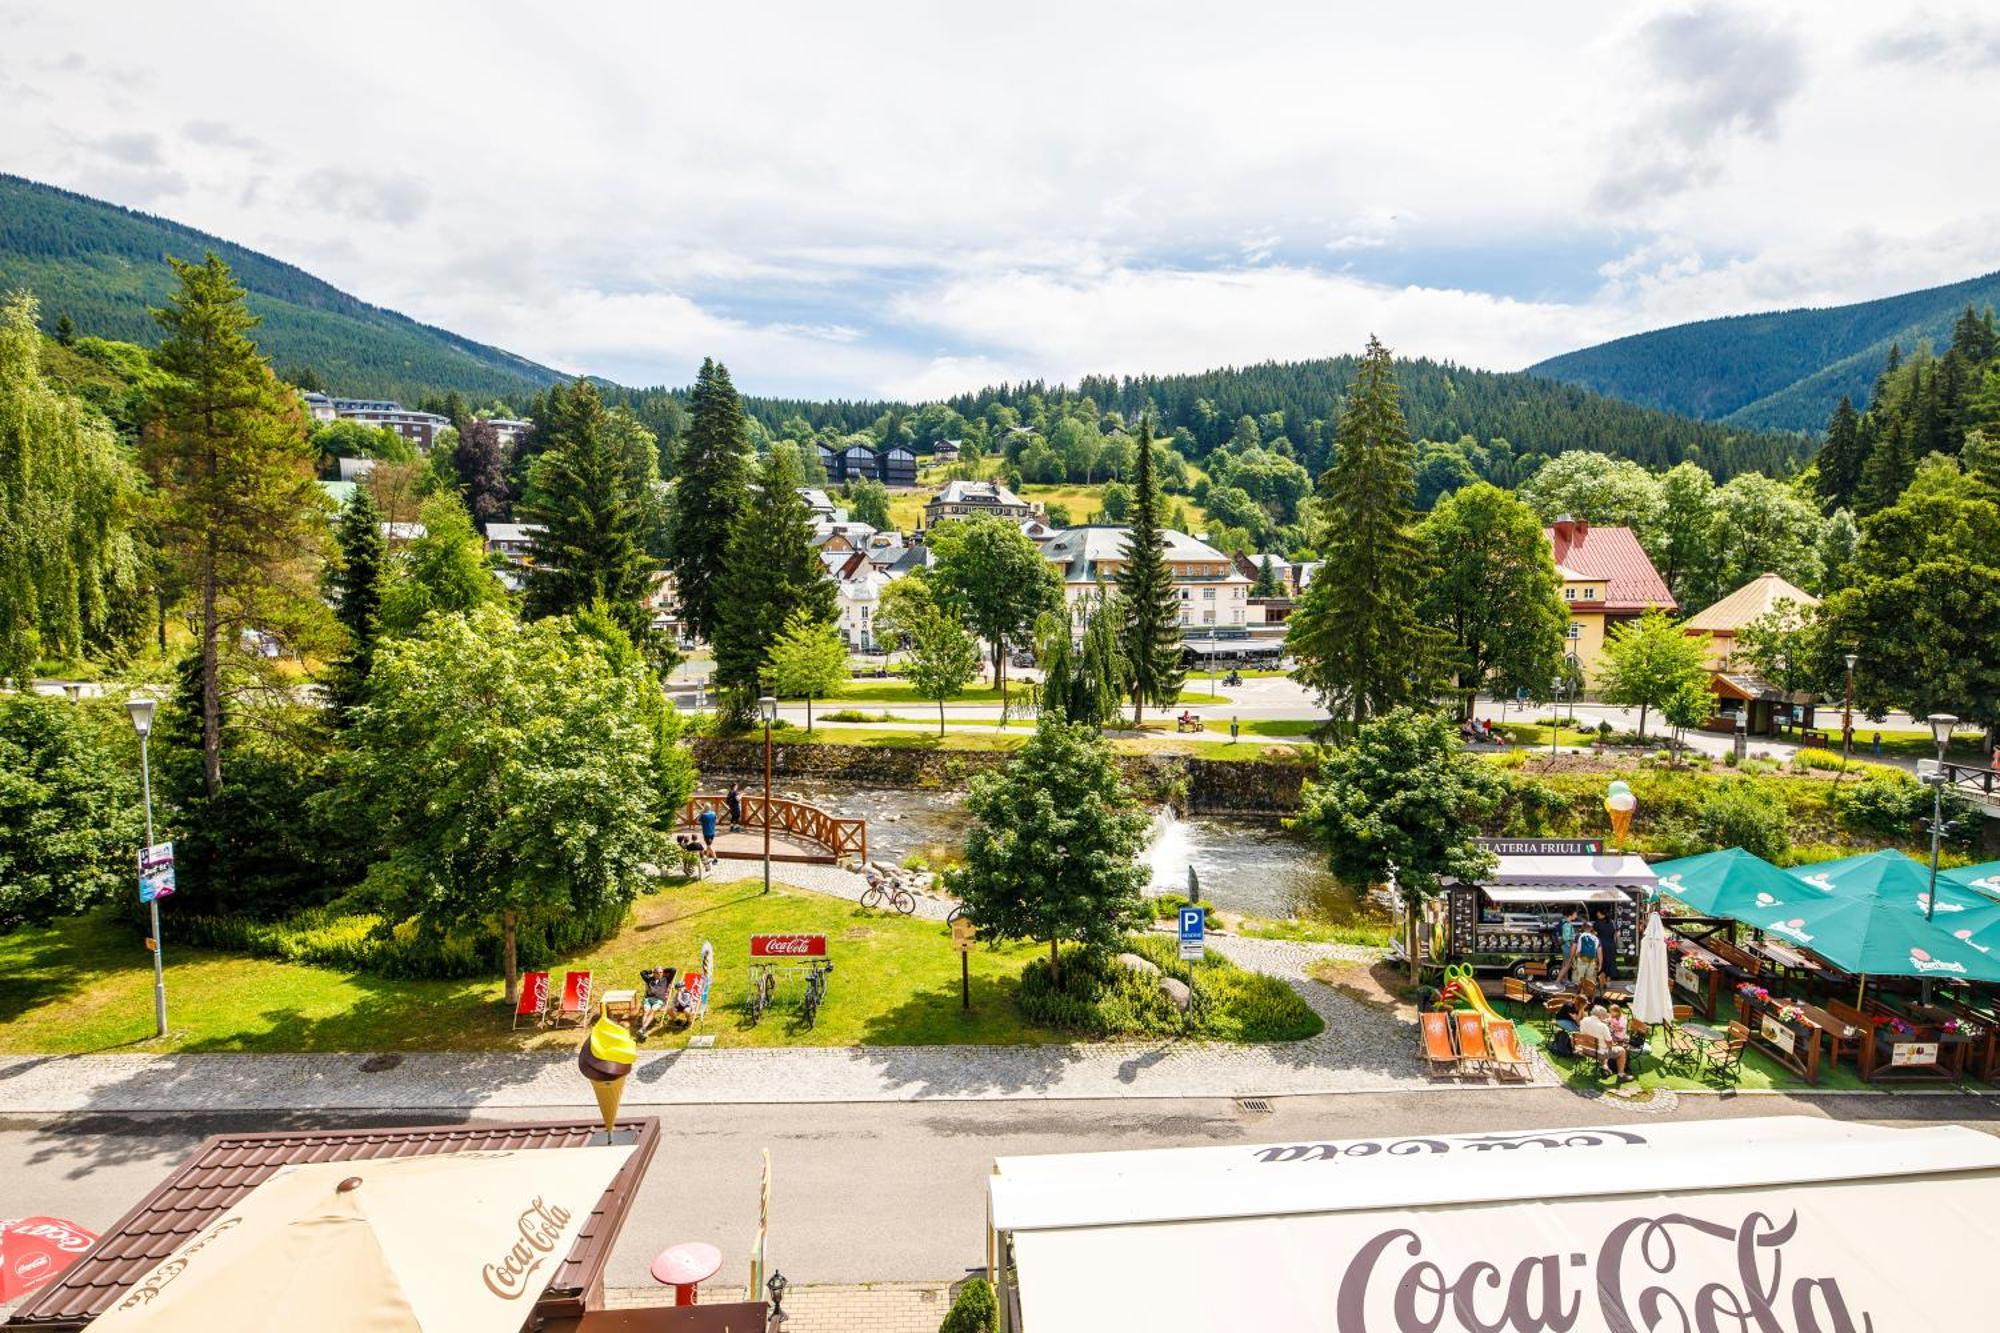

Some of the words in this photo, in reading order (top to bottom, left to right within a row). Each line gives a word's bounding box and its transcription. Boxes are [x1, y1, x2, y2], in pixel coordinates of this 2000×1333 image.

[1478, 842, 1537, 853] ELATERIA
[1540, 842, 1581, 853] FRIULI
[1185, 912, 1198, 931] P
[765, 938, 811, 954] Coca-Cola
[1252, 1129, 1648, 1163] CocaCola
[482, 1194, 572, 1300] Coca-Cola
[1337, 1207, 1873, 1333] Coca-Cola
